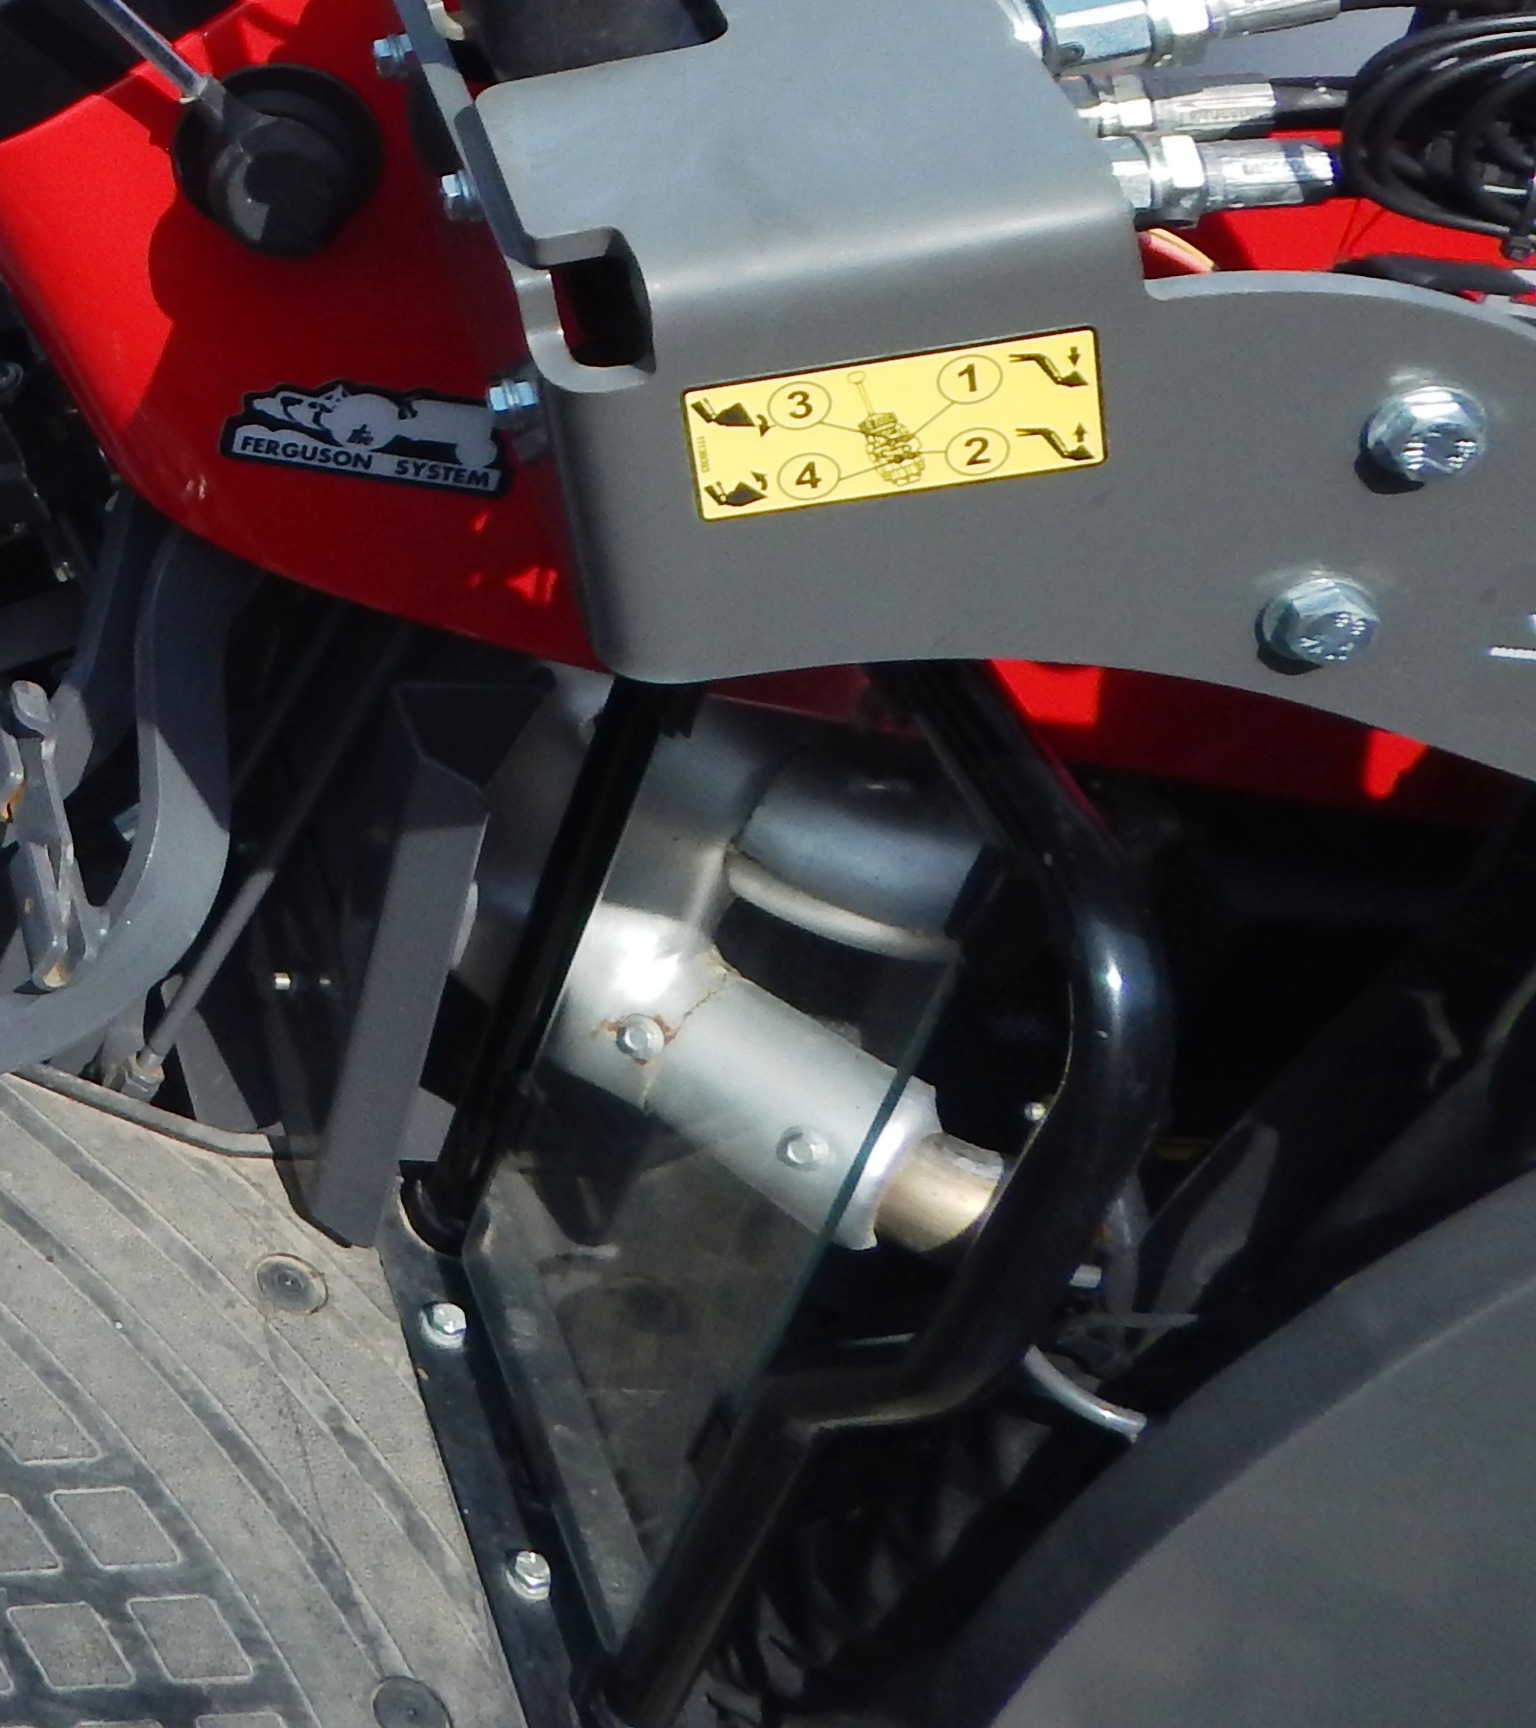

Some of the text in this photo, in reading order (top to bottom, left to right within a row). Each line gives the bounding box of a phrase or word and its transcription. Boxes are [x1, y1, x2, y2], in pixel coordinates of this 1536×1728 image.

[957, 363, 978, 393] 1
[786, 390, 813, 419] 3
[346, 424, 374, 445] the
[240, 435, 490, 489] FERGUSON SYSTEM
[963, 437, 991, 466] 2
[794, 461, 822, 489] 4
